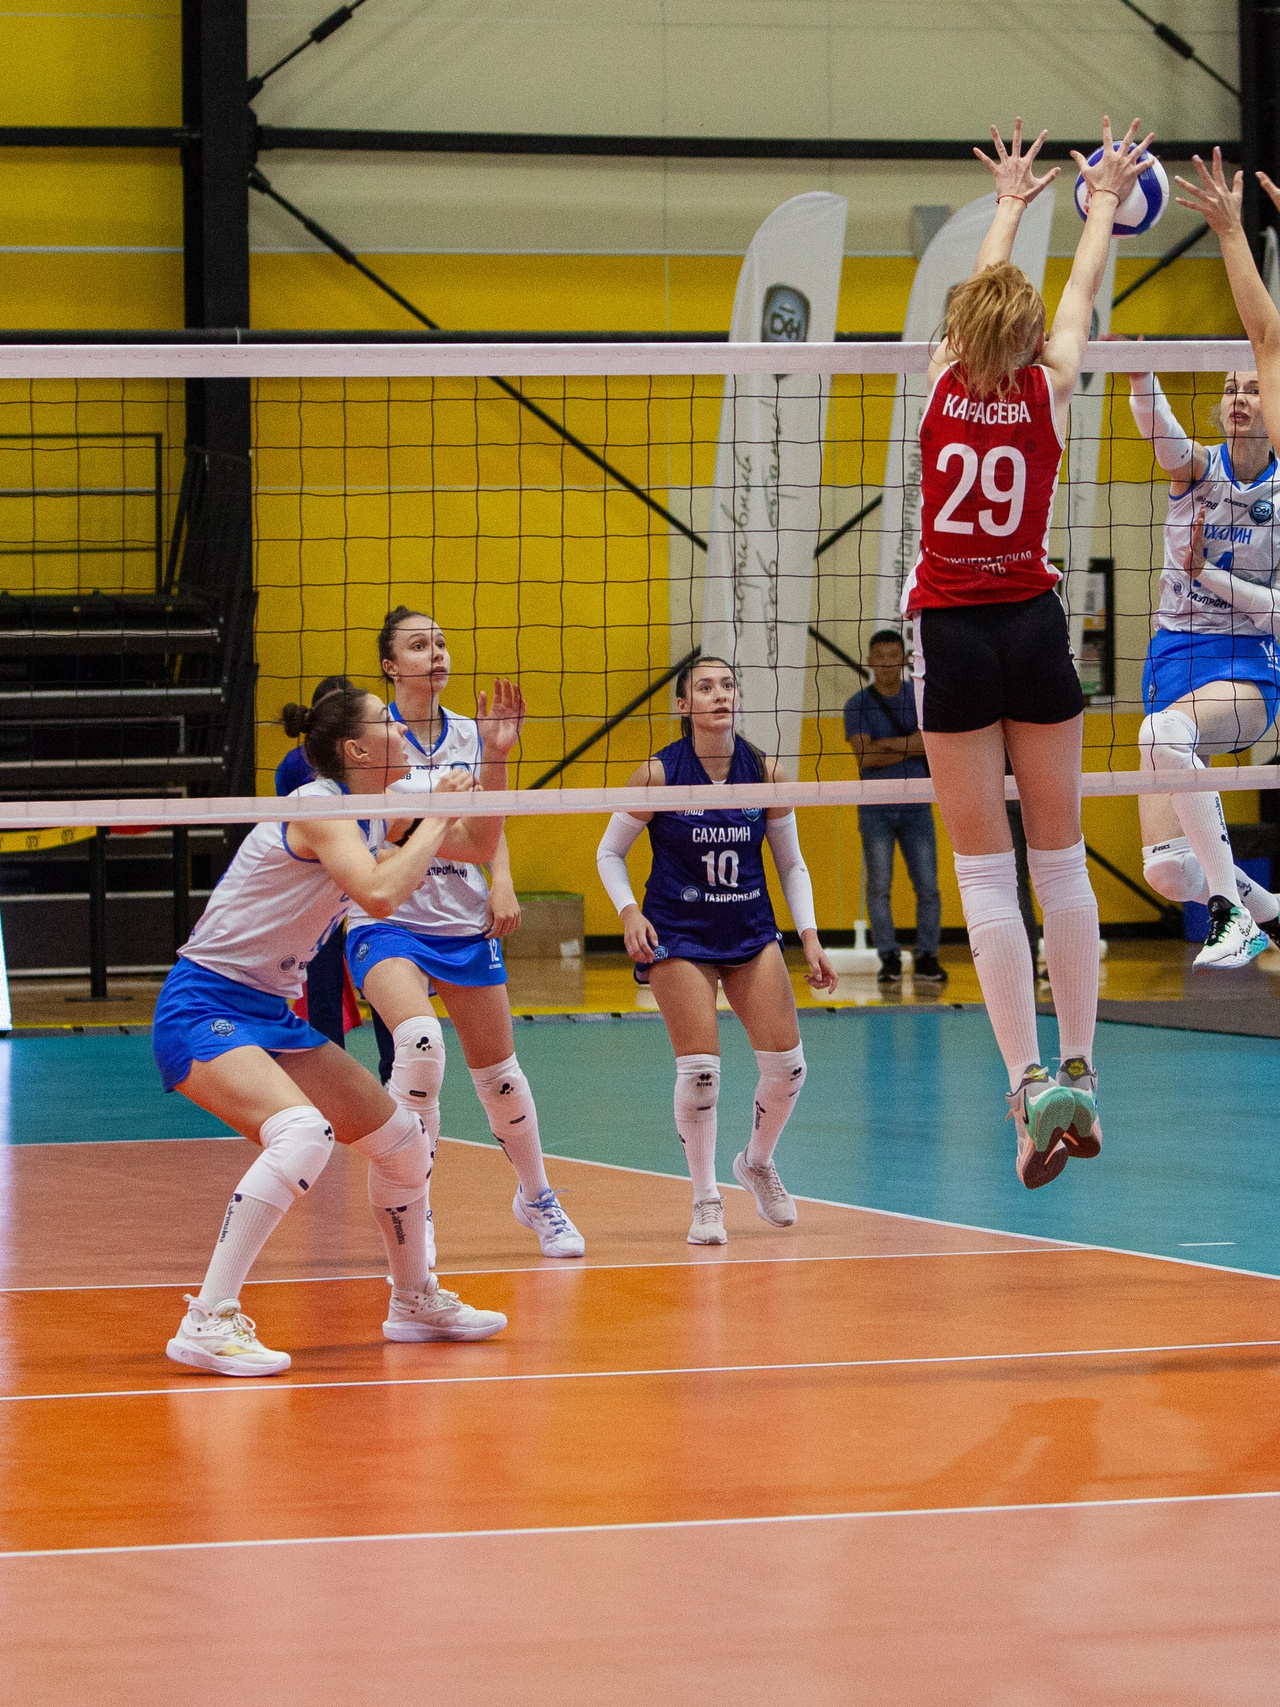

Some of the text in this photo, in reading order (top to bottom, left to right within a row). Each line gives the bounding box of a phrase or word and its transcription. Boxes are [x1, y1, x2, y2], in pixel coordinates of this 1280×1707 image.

[942, 393, 1032, 425] КАРАСЁВА
[933, 442, 1027, 537] 29
[1204, 523, 1252, 545] ХАЛИН
[692, 826, 751, 843] САХАЛИН
[701, 850, 739, 888] 10
[704, 888, 761, 903] ГАЗПРОМБАНК
